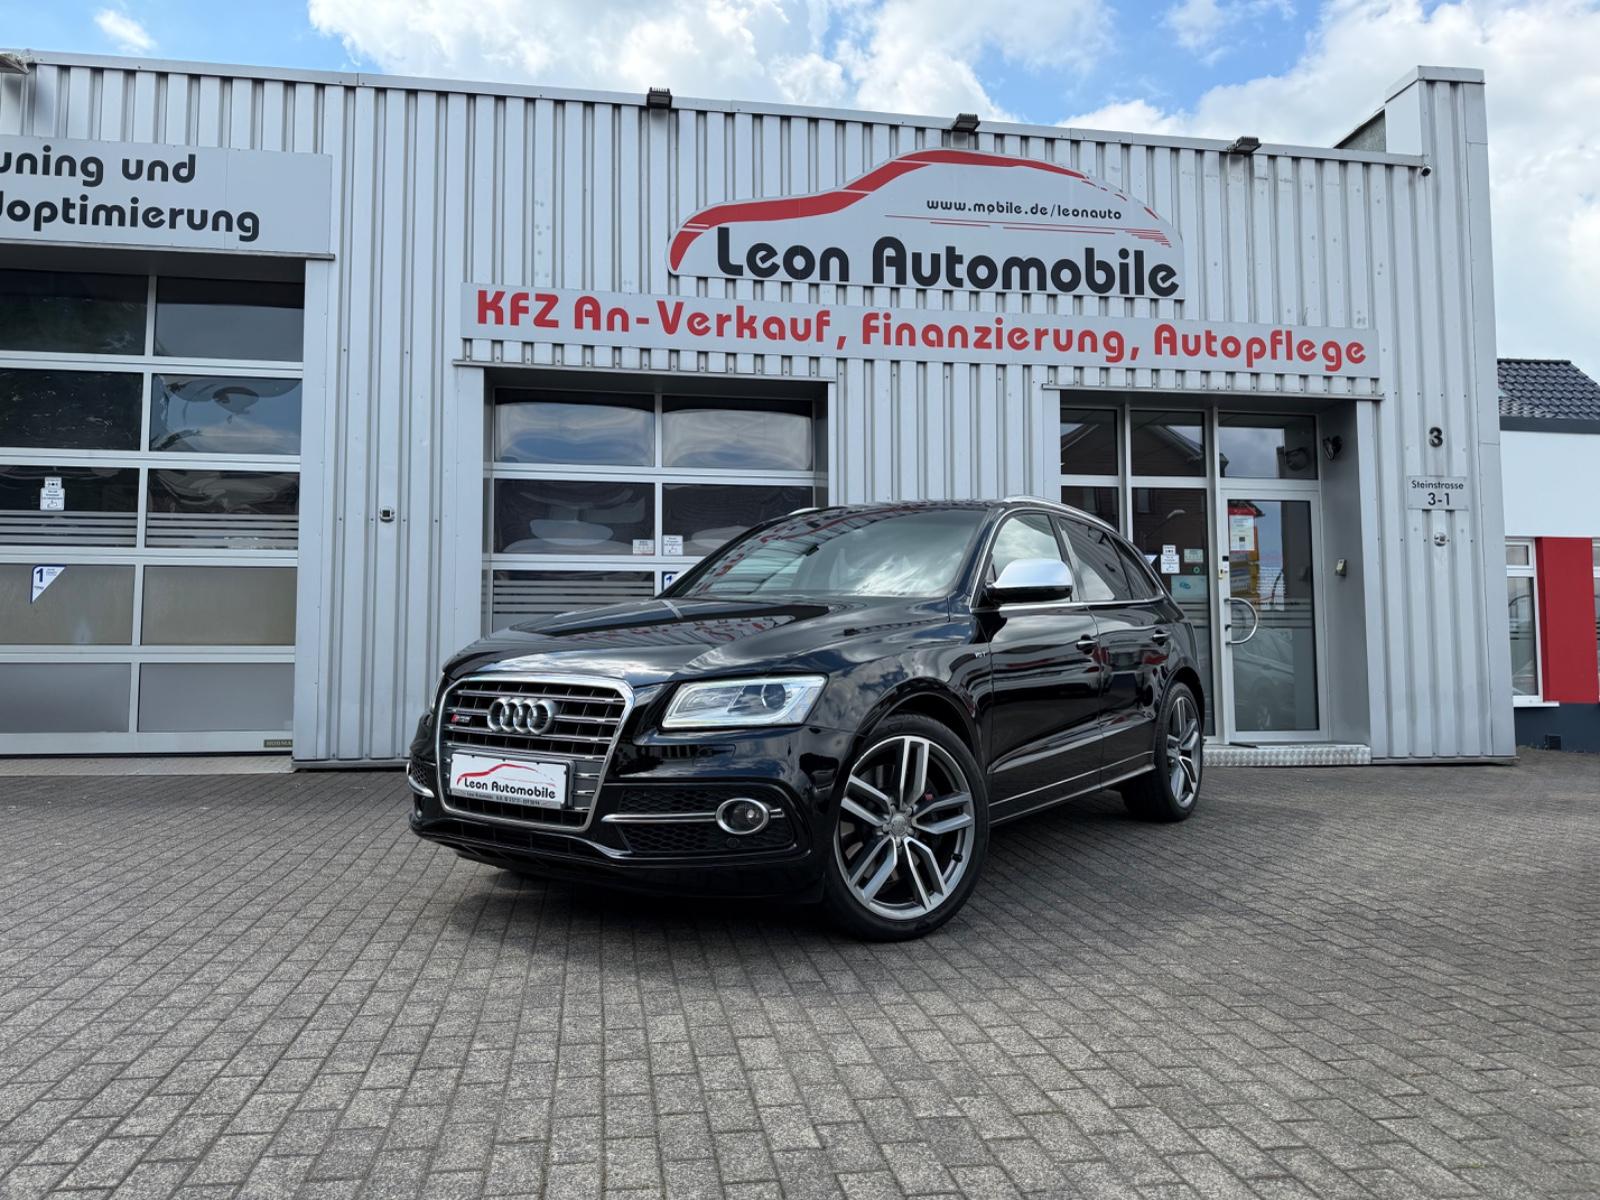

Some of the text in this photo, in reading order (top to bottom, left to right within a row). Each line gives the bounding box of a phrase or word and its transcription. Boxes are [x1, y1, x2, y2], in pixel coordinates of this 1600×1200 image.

[122, 153, 196, 183] und
[0, 191, 260, 243] optimierung
[926, 200, 1122, 220] www.mobile.de/leonauto
[718, 226, 1180, 298] Leon Automobile
[574, 295, 846, 349] An-Verkauf,
[1154, 323, 1365, 373] Autopflege
[1429, 426, 1443, 448] 3
[1411, 480, 1464, 490] Steinstrasse
[1427, 491, 1450, 506] 3-1
[36, 567, 44, 583] 1
[464, 777, 488, 791] Leon
[491, 781, 556, 799] Automobile
